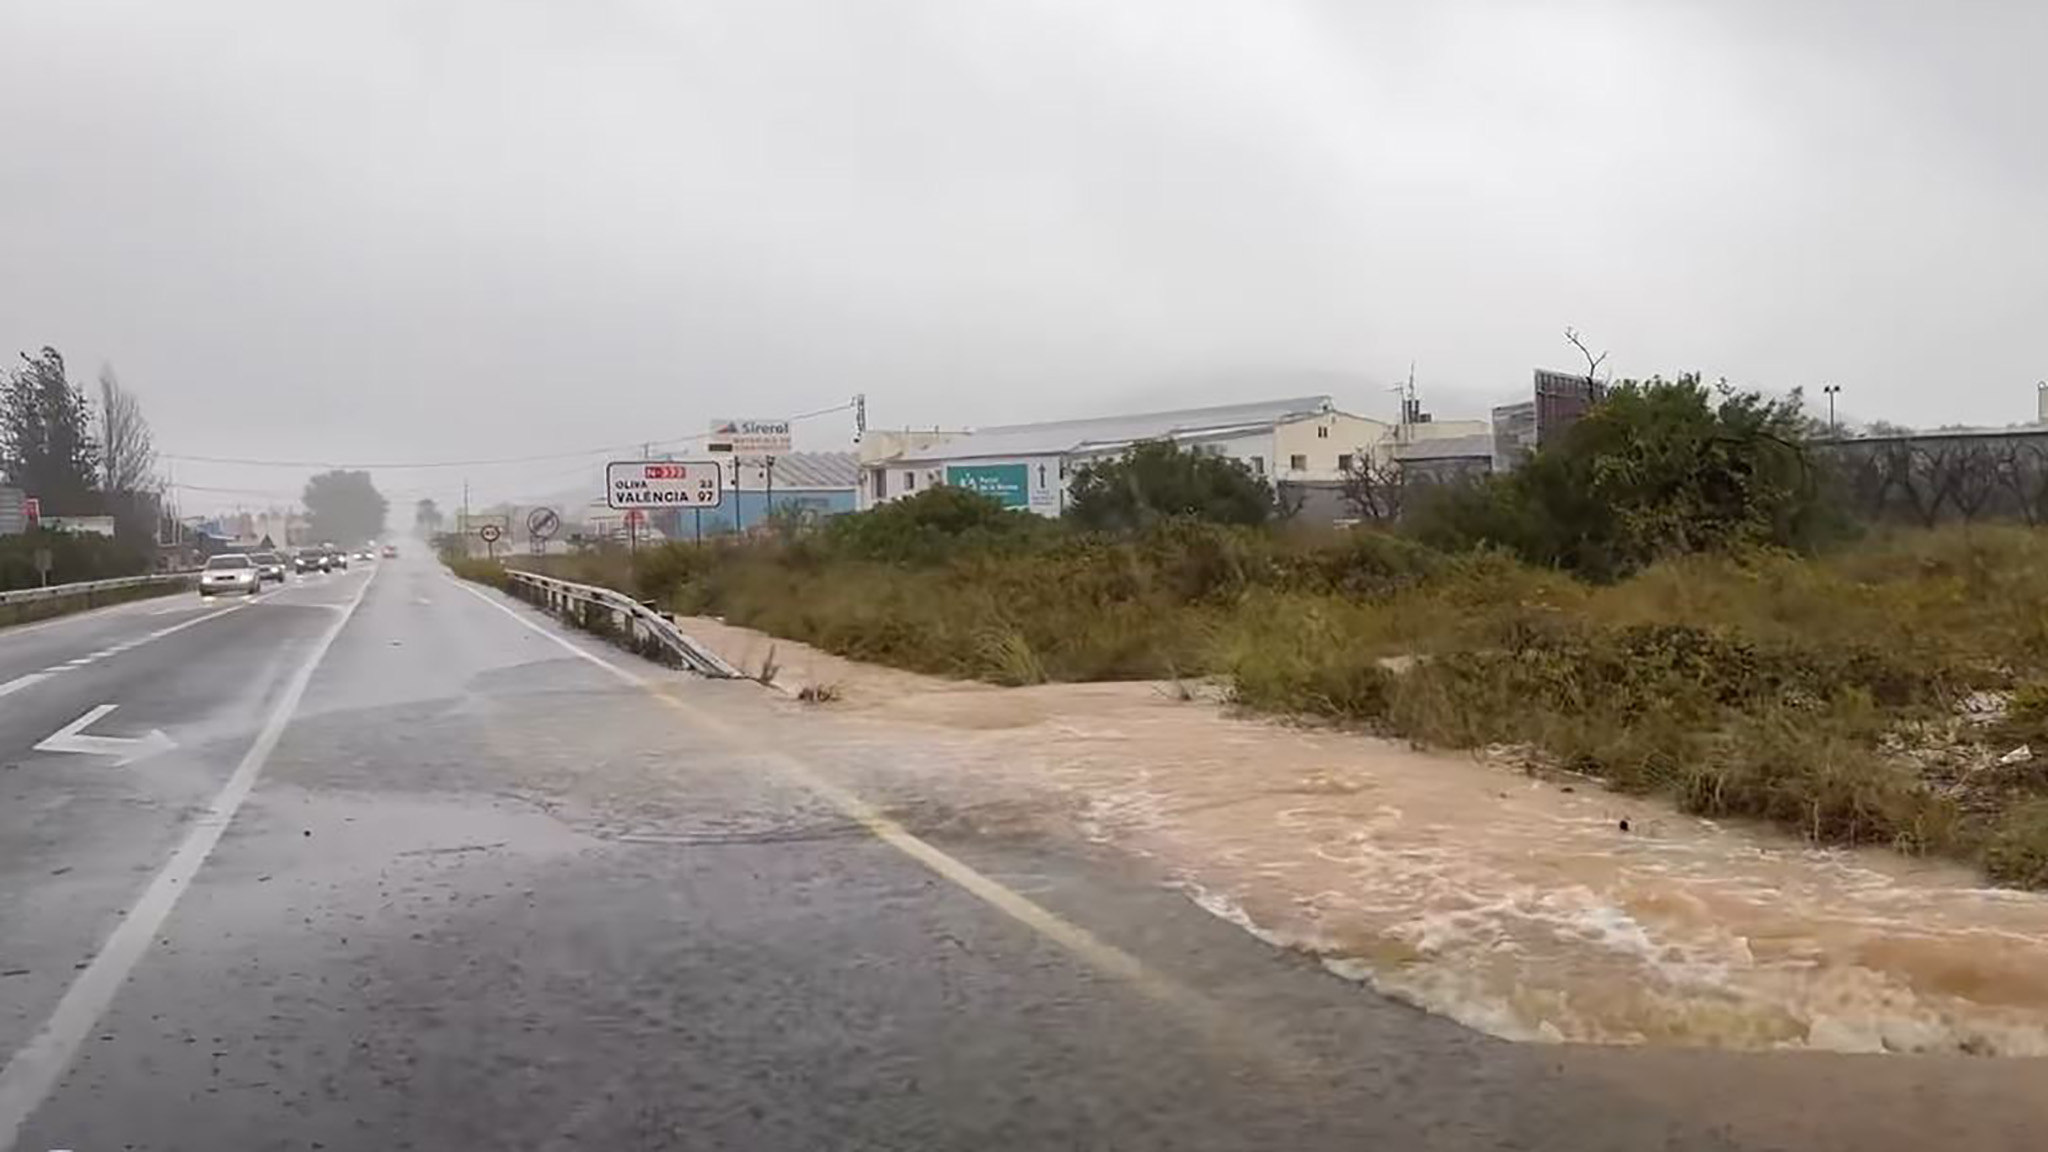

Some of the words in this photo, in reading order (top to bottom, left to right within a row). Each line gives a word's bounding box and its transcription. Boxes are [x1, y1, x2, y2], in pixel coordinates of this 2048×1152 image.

[742, 421, 789, 435] Sirerol
[615, 479, 648, 489] OLIVA
[698, 490, 713, 502] 97
